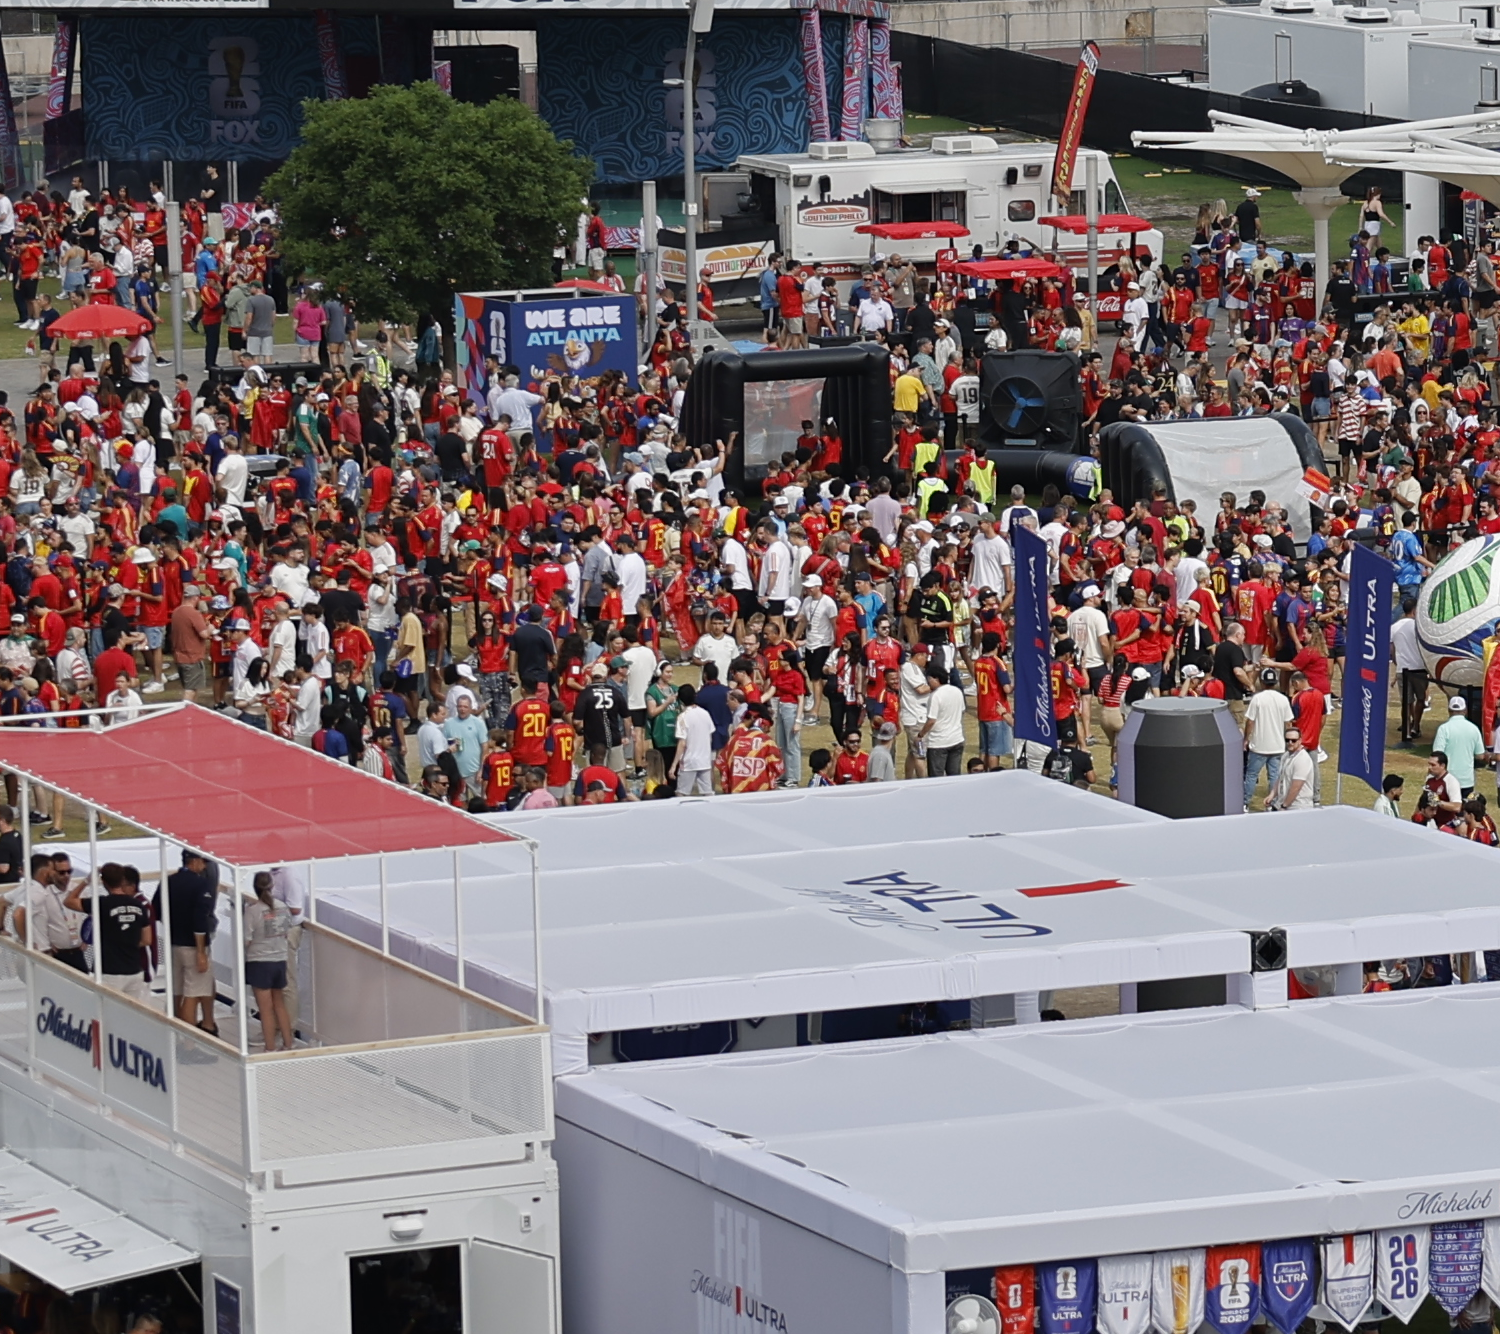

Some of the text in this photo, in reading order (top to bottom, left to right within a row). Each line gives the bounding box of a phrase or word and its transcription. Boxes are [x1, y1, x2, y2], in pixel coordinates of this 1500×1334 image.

[210, 120, 262, 145] FOX
[524, 304, 622, 330] WE ARE
[526, 326, 621, 347] ATLANTA
[1361, 577, 1378, 661] ULTRA
[732, 756, 766, 778] ESP
[37, 996, 92, 1053] Michelob
[108, 1033, 167, 1093] ULTRA
[1397, 1188, 1494, 1219] Michelob
[25, 1218, 115, 1263] ULTRA
[1103, 1290, 1149, 1305] ULTRA
[1391, 1267, 1419, 1300] 26
[690, 1269, 788, 1334] Michelob ULTRA
[1052, 1309, 1083, 1321] ULTRA
